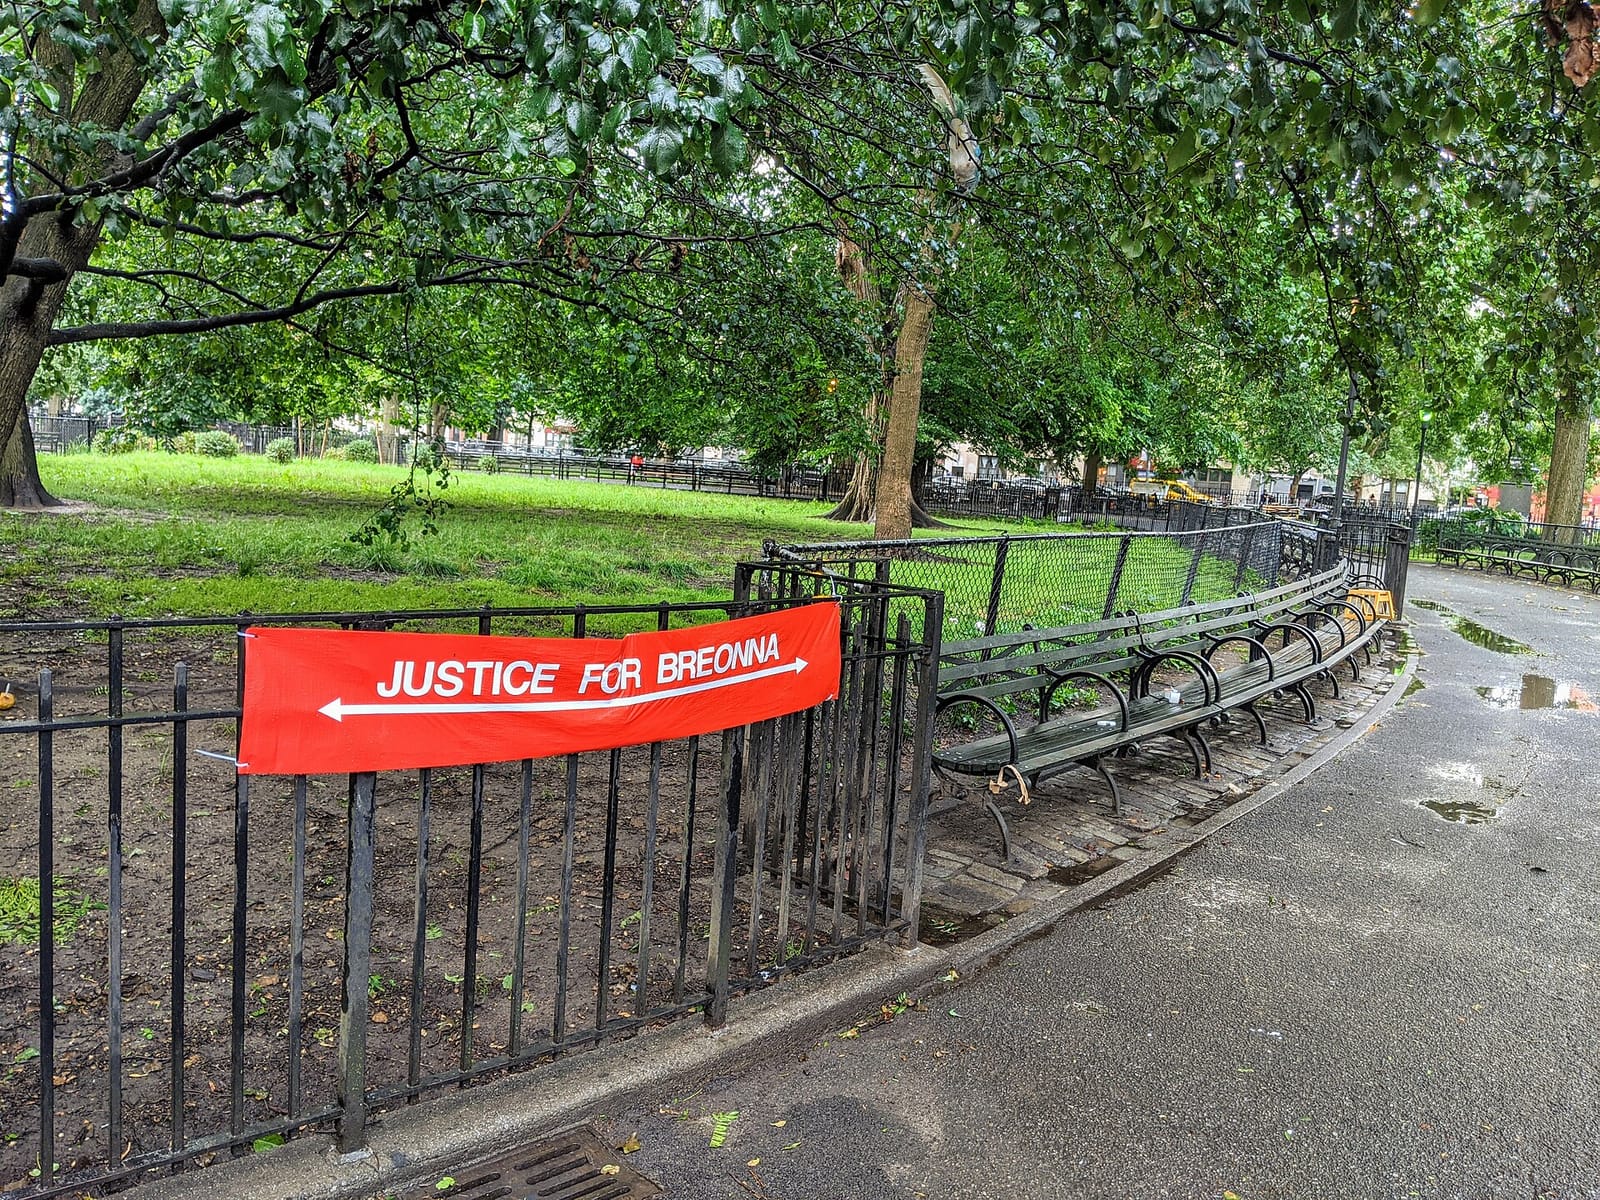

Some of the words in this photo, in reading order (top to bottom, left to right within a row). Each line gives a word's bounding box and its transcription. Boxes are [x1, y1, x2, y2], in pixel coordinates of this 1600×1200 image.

[377, 660, 557, 697] JUSTICE
[579, 657, 642, 694] FOR
[657, 633, 780, 684] BREONNA
